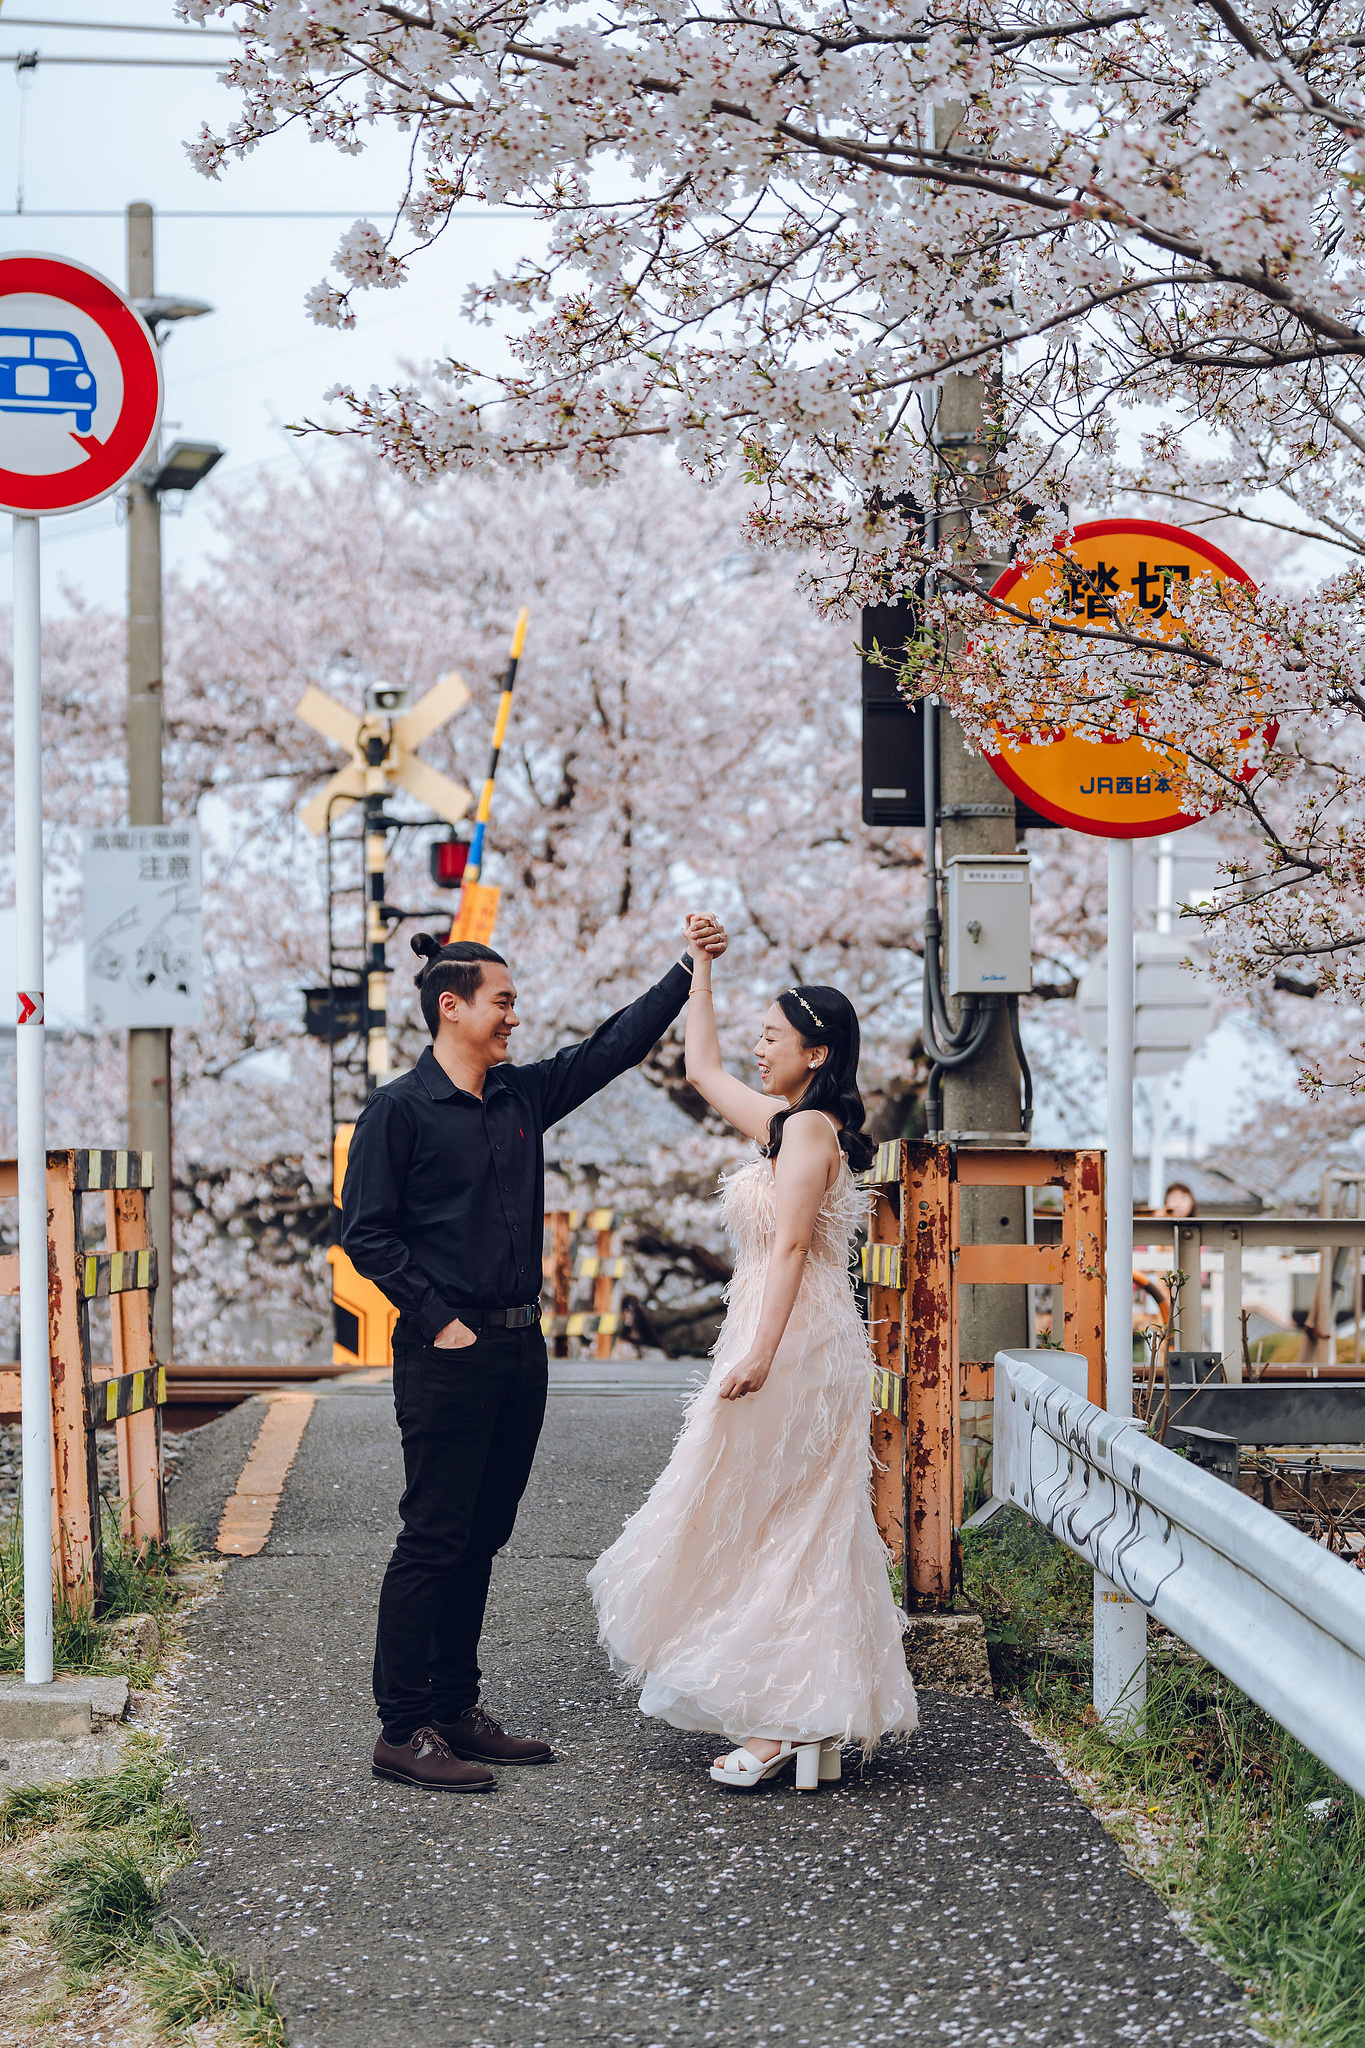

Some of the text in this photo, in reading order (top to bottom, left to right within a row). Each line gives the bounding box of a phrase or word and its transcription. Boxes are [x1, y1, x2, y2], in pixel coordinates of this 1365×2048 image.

[1062, 561, 1190, 619] 踏切
[1080, 777, 1172, 794] JR西日本
